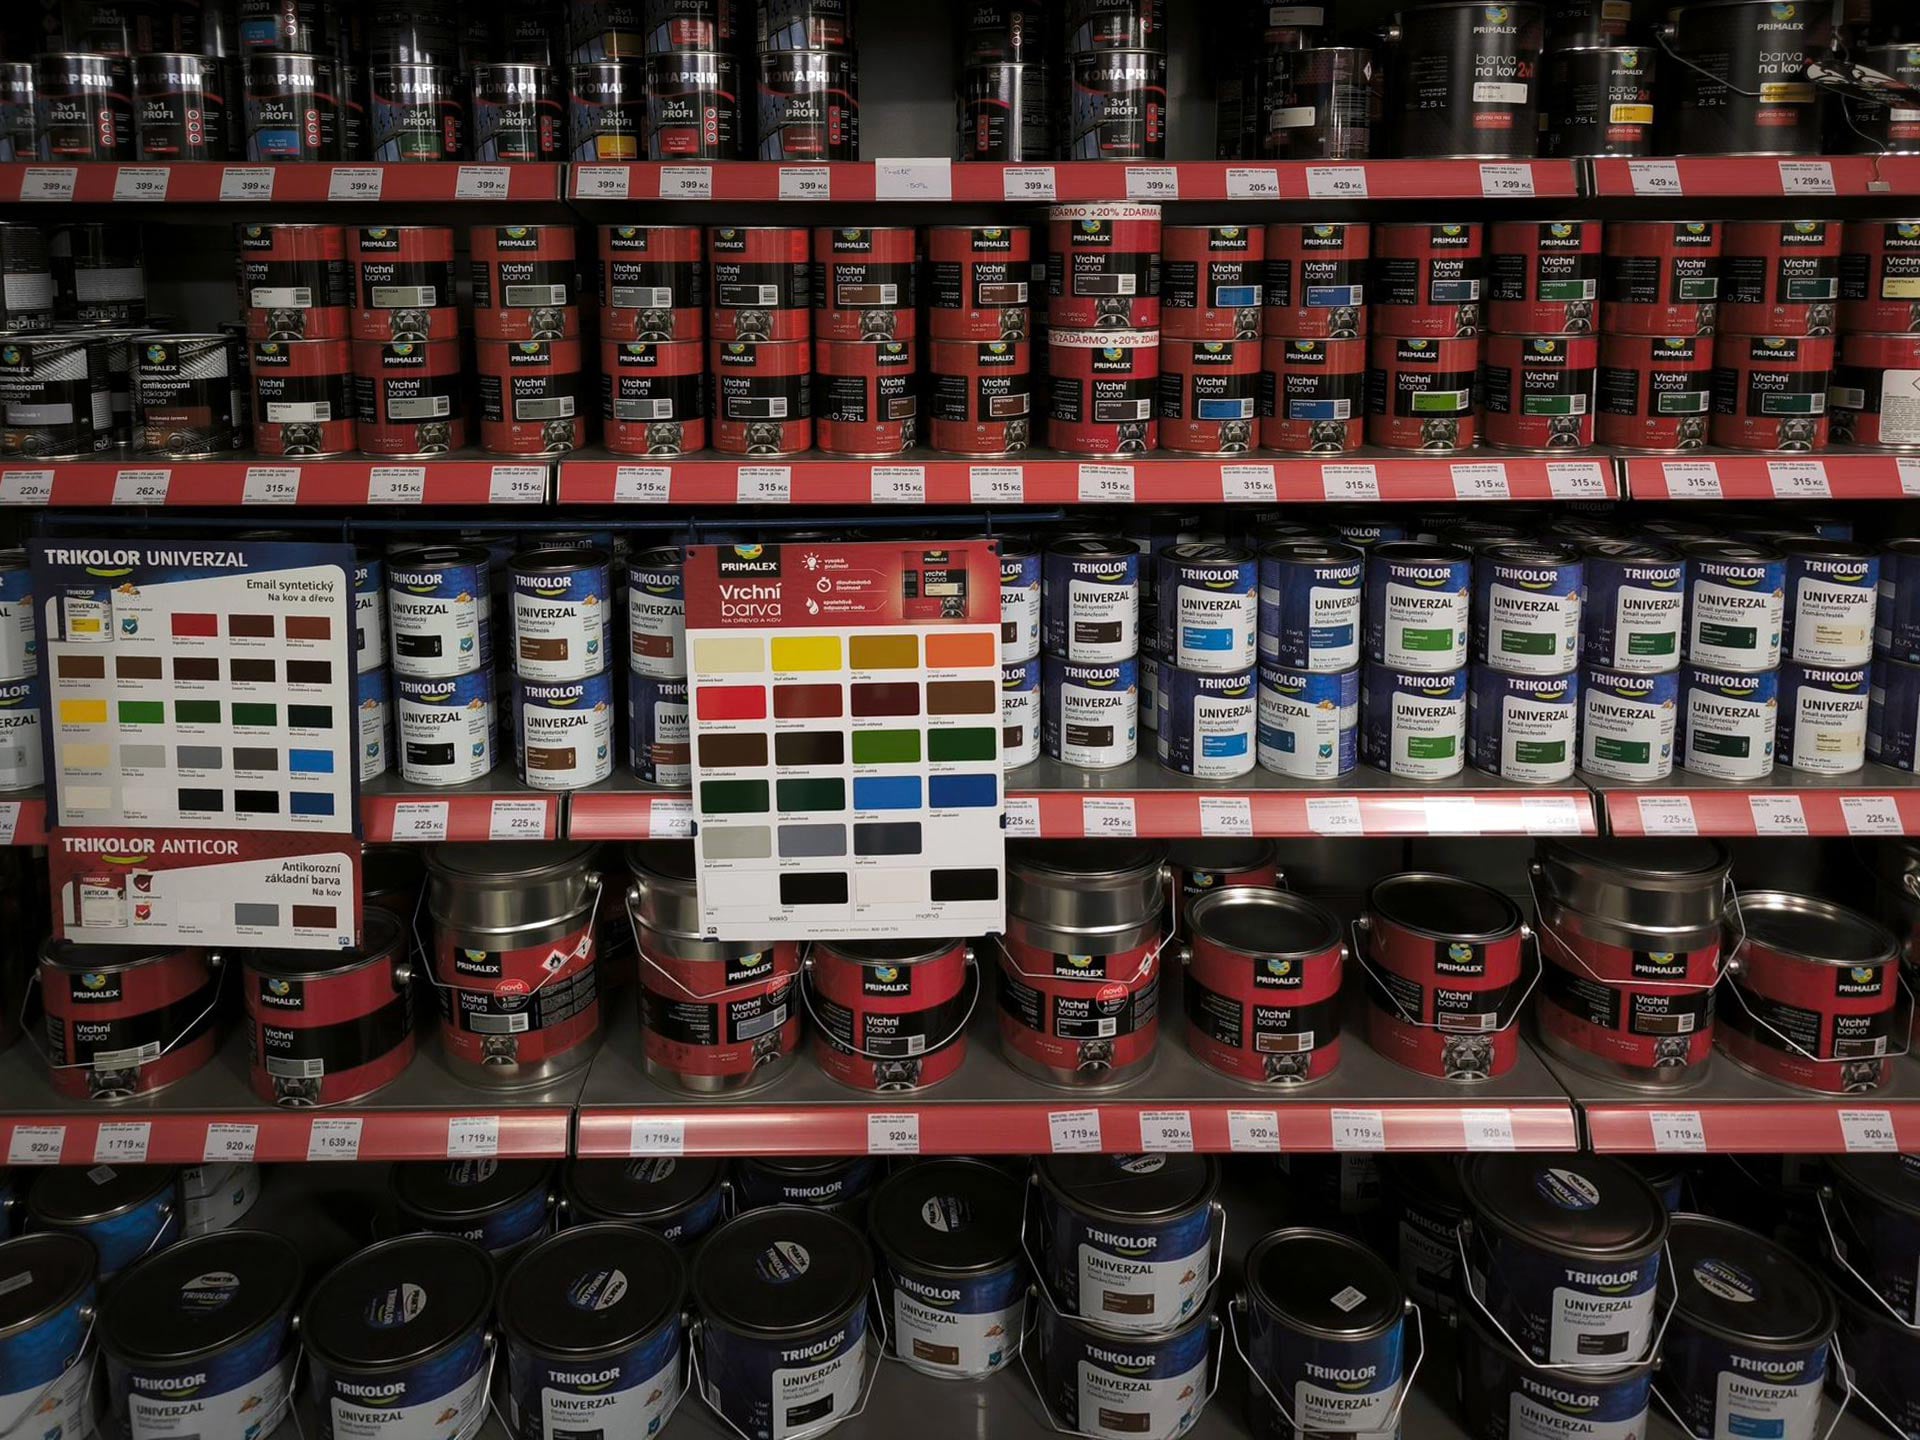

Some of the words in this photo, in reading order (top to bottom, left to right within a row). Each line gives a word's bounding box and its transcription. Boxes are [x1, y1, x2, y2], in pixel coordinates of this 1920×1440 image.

[1757, 23, 1804, 31] PRIMALEX
[1476, 54, 1516, 65] barva
[1759, 50, 1803, 62] barva
[1475, 68, 1492, 76] na
[1497, 65, 1517, 76] kov
[1758, 63, 1777, 73] na
[264, 103, 284, 111] 3v1
[667, 101, 686, 110] 3v1
[792, 100, 811, 109] 3v1
[1110, 98, 1130, 107] 3v1
[259, 111, 293, 120] PROFI
[662, 109, 693, 118] PROFI
[785, 108, 819, 118] PROFI
[1103, 106, 1137, 116] PROFI
[241, 182, 259, 190] 399
[680, 180, 698, 189] 399
[799, 181, 817, 190] 399
[1024, 181, 1042, 190] 399
[1249, 183, 1266, 191] 205
[1649, 178, 1667, 187] 429
[1090, 208, 1119, 216] +20%
[1123, 208, 1157, 216] ZDARMA
[1073, 235, 1111, 243] PRIMALEX
[1541, 239, 1580, 247] PRIMALEX
[498, 240, 536, 248] PRIMALEX
[1074, 254, 1106, 263] Vrchní
[1542, 256, 1574, 266] Vrchní
[364, 264, 394, 274] Vrchní
[501, 263, 533, 273] Vrchní
[1075, 263, 1101, 272] barva
[1542, 265, 1571, 274] barva
[365, 273, 391, 282] barva
[502, 272, 530, 281] barva
[1112, 336, 1139, 344] +20%
[1752, 349, 1796, 357] PRIMALEX
[1753, 373, 1790, 384] Vrchní
[142, 381, 190, 389] antikorozní
[1096, 382, 1127, 390] Vrchní
[1753, 383, 1784, 391] barva
[636, 482, 655, 491] 315
[1101, 481, 1119, 490] 315
[1474, 479, 1493, 488] 315
[1688, 478, 1706, 486] 315
[20, 486, 39, 495] 220
[136, 487, 156, 495] 262
[265, 484, 285, 493] 315
[511, 483, 530, 491] 315
[44, 549, 141, 566] TRIKOLOR
[147, 551, 248, 568] UNIVERZAL
[721, 563, 777, 571] PRIMALEX
[1072, 562, 1128, 574] TRIKOLOR
[1804, 560, 1869, 573] TRIKOLOR
[1181, 568, 1239, 581] TRIKOLOR
[1390, 565, 1450, 579] TRIKOLOR
[247, 580, 275, 590] Email
[279, 580, 334, 593] syntetický
[719, 582, 782, 599] Vrchní
[268, 593, 279, 601] Na
[282, 593, 297, 602] kov
[308, 593, 335, 603] dřevo
[1073, 591, 1129, 603] UNIVERZAL
[1803, 591, 1869, 603] UNIVERZAL
[1181, 598, 1242, 610] UNIVERZAL
[1390, 596, 1453, 609] UNIVERZAL
[722, 601, 782, 616] barva
[1064, 667, 1120, 679] TRIKOLOR
[1508, 678, 1568, 691] TRIKOLOR
[525, 685, 583, 698] TRIKOLOR
[1065, 696, 1122, 708] UNIVERZAL
[1508, 709, 1568, 721] UNIVERZAL
[527, 715, 588, 727] UNIVERZAL
[512, 819, 528, 827] 225
[1103, 817, 1119, 826] 225
[1867, 815, 1884, 823] 225
[415, 821, 431, 829] 225
[62, 837, 155, 854] TRIKOLOR
[161, 839, 239, 855] ANTICOR
[282, 861, 341, 873] Antikorozní
[265, 873, 308, 885] základní
[311, 874, 341, 885] barva
[312, 888, 323, 896] Na
[325, 888, 342, 897] kov
[1635, 964, 1684, 975] PRIMALEX
[1256, 976, 1300, 984] PRIMALEX
[865, 983, 908, 992] PRIMALEX
[73, 990, 119, 999] PRIMALEX
[1636, 995, 1669, 1006] Vrchní
[1636, 1003, 1668, 1013] barva
[1257, 1008, 1291, 1019] Vrchní
[866, 1016, 899, 1027] Vrchní
[1257, 1019, 1287, 1027] barva
[77, 1023, 111, 1034] Vrchní
[867, 1025, 896, 1034] barva
[77, 1033, 107, 1041] barva
[1250, 1129, 1267, 1137] 920
[1864, 1129, 1882, 1139] 920
[227, 1141, 244, 1150] 920
[1086, 1227, 1157, 1248] TRIKOLOR
[1087, 1256, 1154, 1275] UNIVERZAL
[1564, 1269, 1638, 1286] TRIKOLOR
[1564, 1299, 1633, 1313] UNIVERZAL
[781, 1330, 844, 1361] TRIKOLOR
[782, 1360, 842, 1386] UNIVERZAL
[1305, 1363, 1376, 1379] TRIKOLOR
[1305, 1394, 1372, 1409] UNIVERZAL
